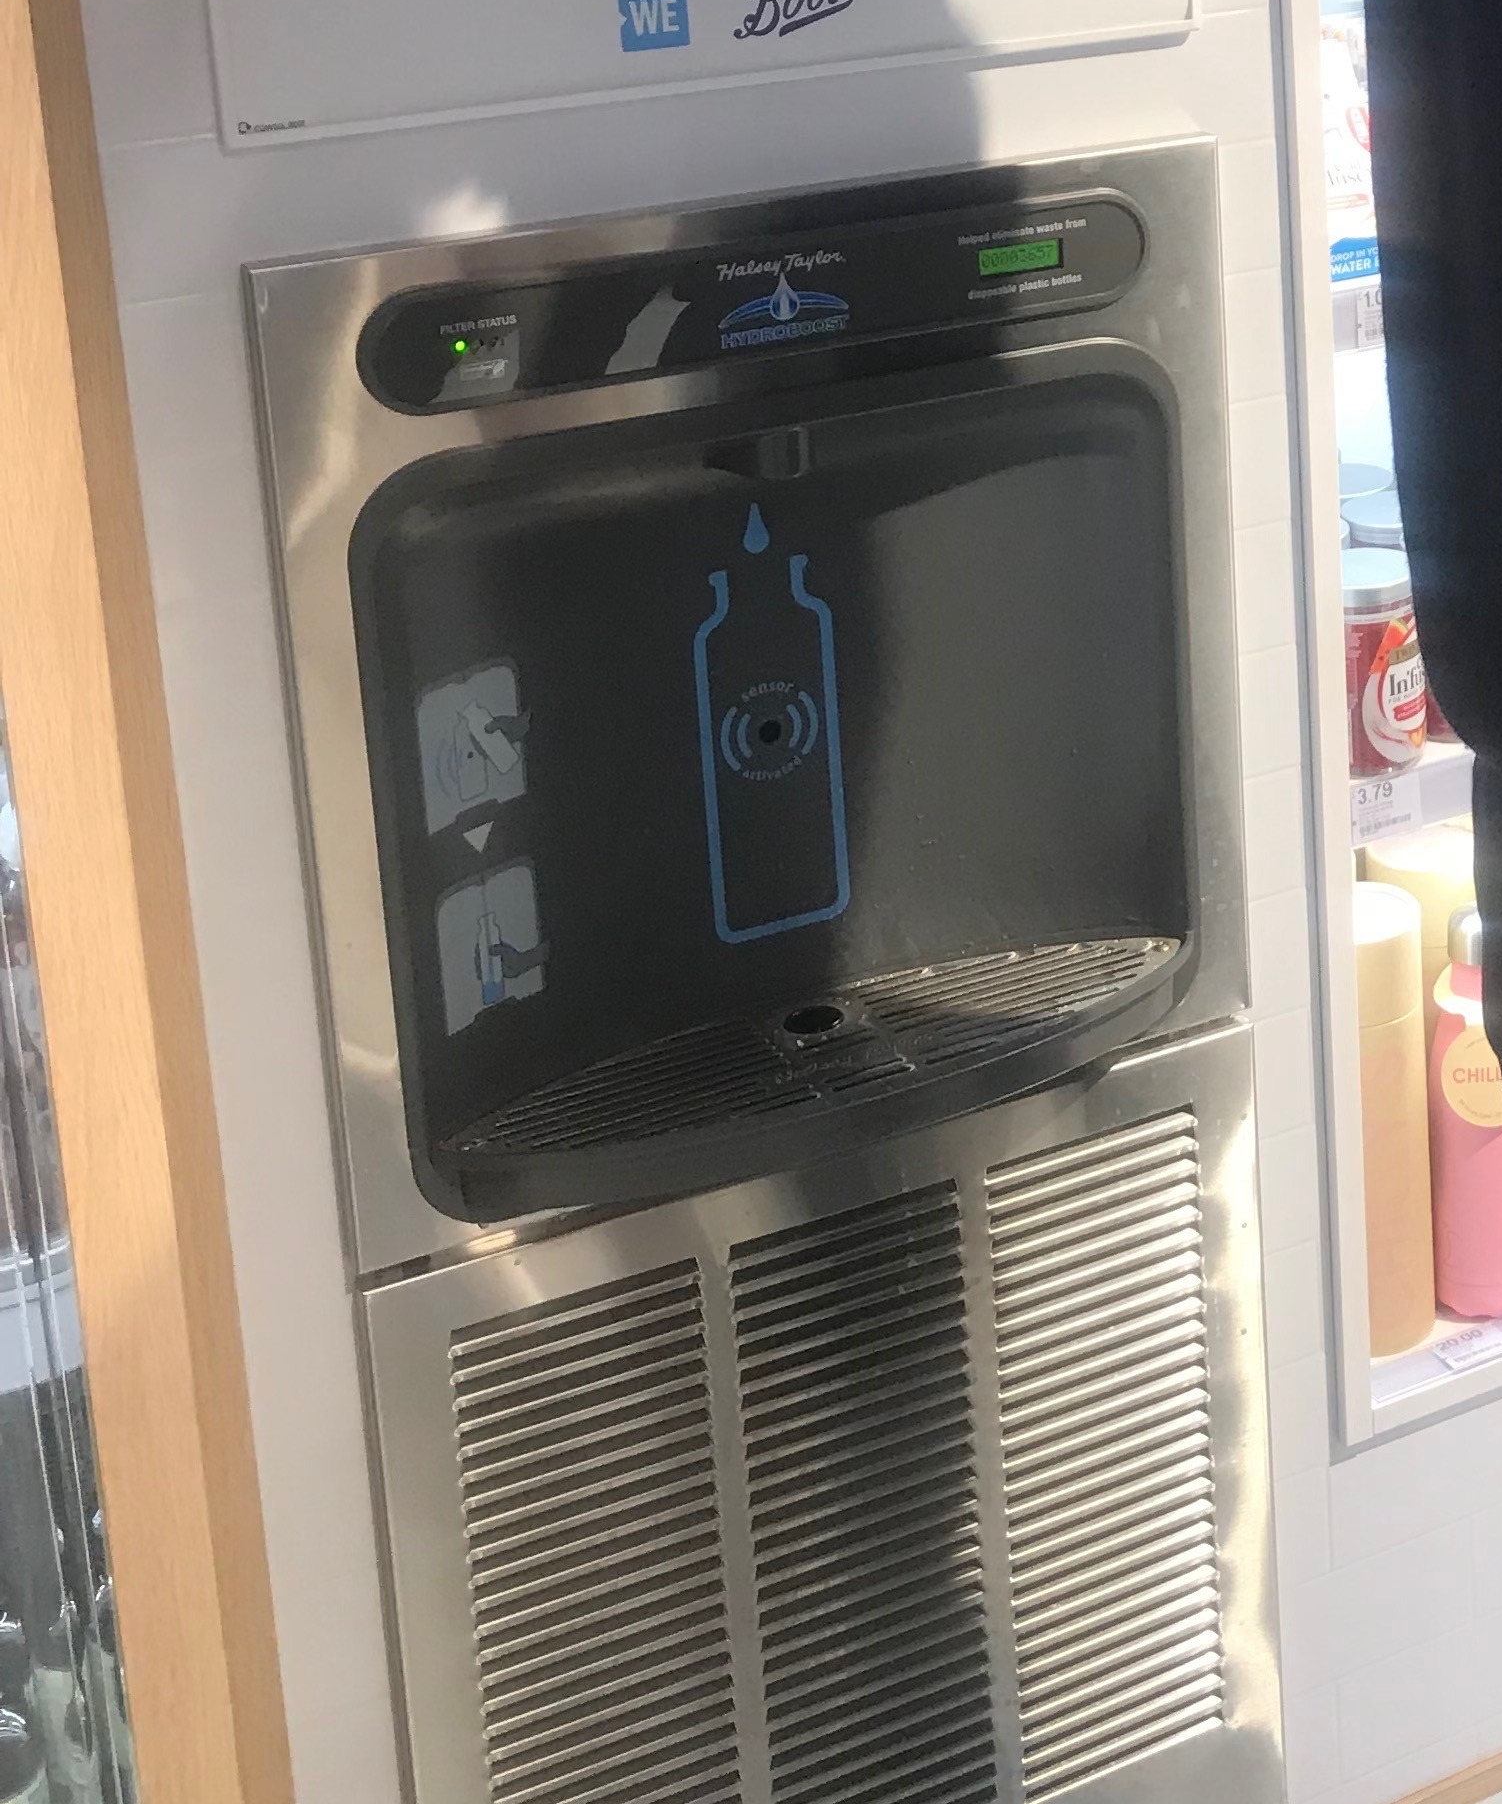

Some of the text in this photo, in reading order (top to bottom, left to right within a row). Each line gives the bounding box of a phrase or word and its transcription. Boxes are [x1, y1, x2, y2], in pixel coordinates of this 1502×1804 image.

[1036, 221, 1064, 235] waste
[1065, 218, 1087, 229] from
[1330, 251, 1355, 263] DROP
[1356, 248, 1366, 259] IN
[1330, 257, 1372, 275] WATER
[716, 259, 782, 281] Halsey
[1019, 278, 1050, 293] plastic
[1051, 273, 1083, 286] bottles
[440, 314, 518, 335] FILTER STATUS
[720, 313, 850, 350] HYDROBOOST
[741, 681, 795, 703] sensor
[1357, 781, 1394, 805] 3.79
